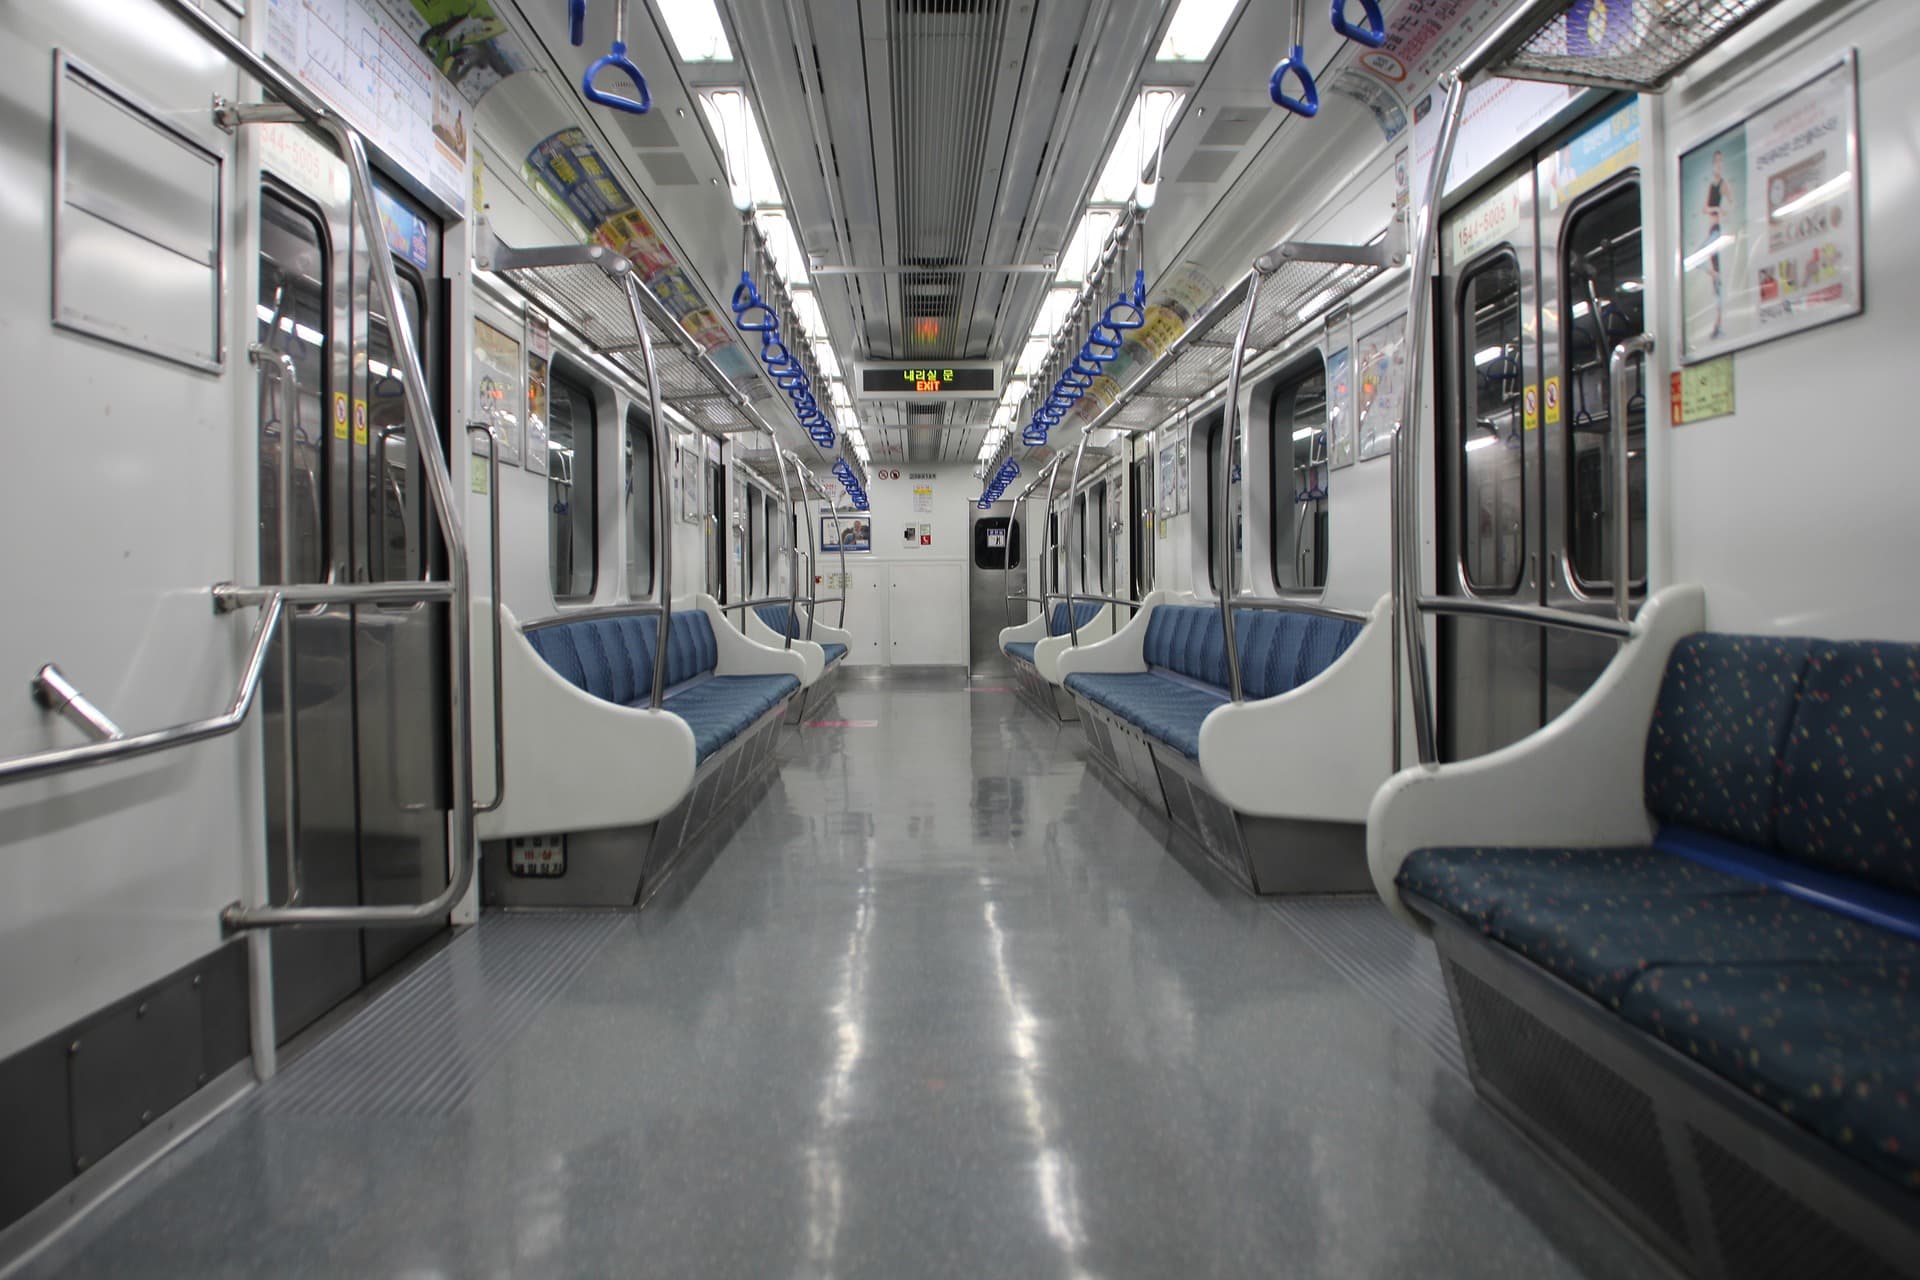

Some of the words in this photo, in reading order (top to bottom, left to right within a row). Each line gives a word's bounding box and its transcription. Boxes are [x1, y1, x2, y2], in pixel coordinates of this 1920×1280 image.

[260, 126, 320, 178] 544-5005
[904, 369, 937, 381] 내리실
[943, 369, 954, 381] 문
[916, 380, 940, 391] EXIT
